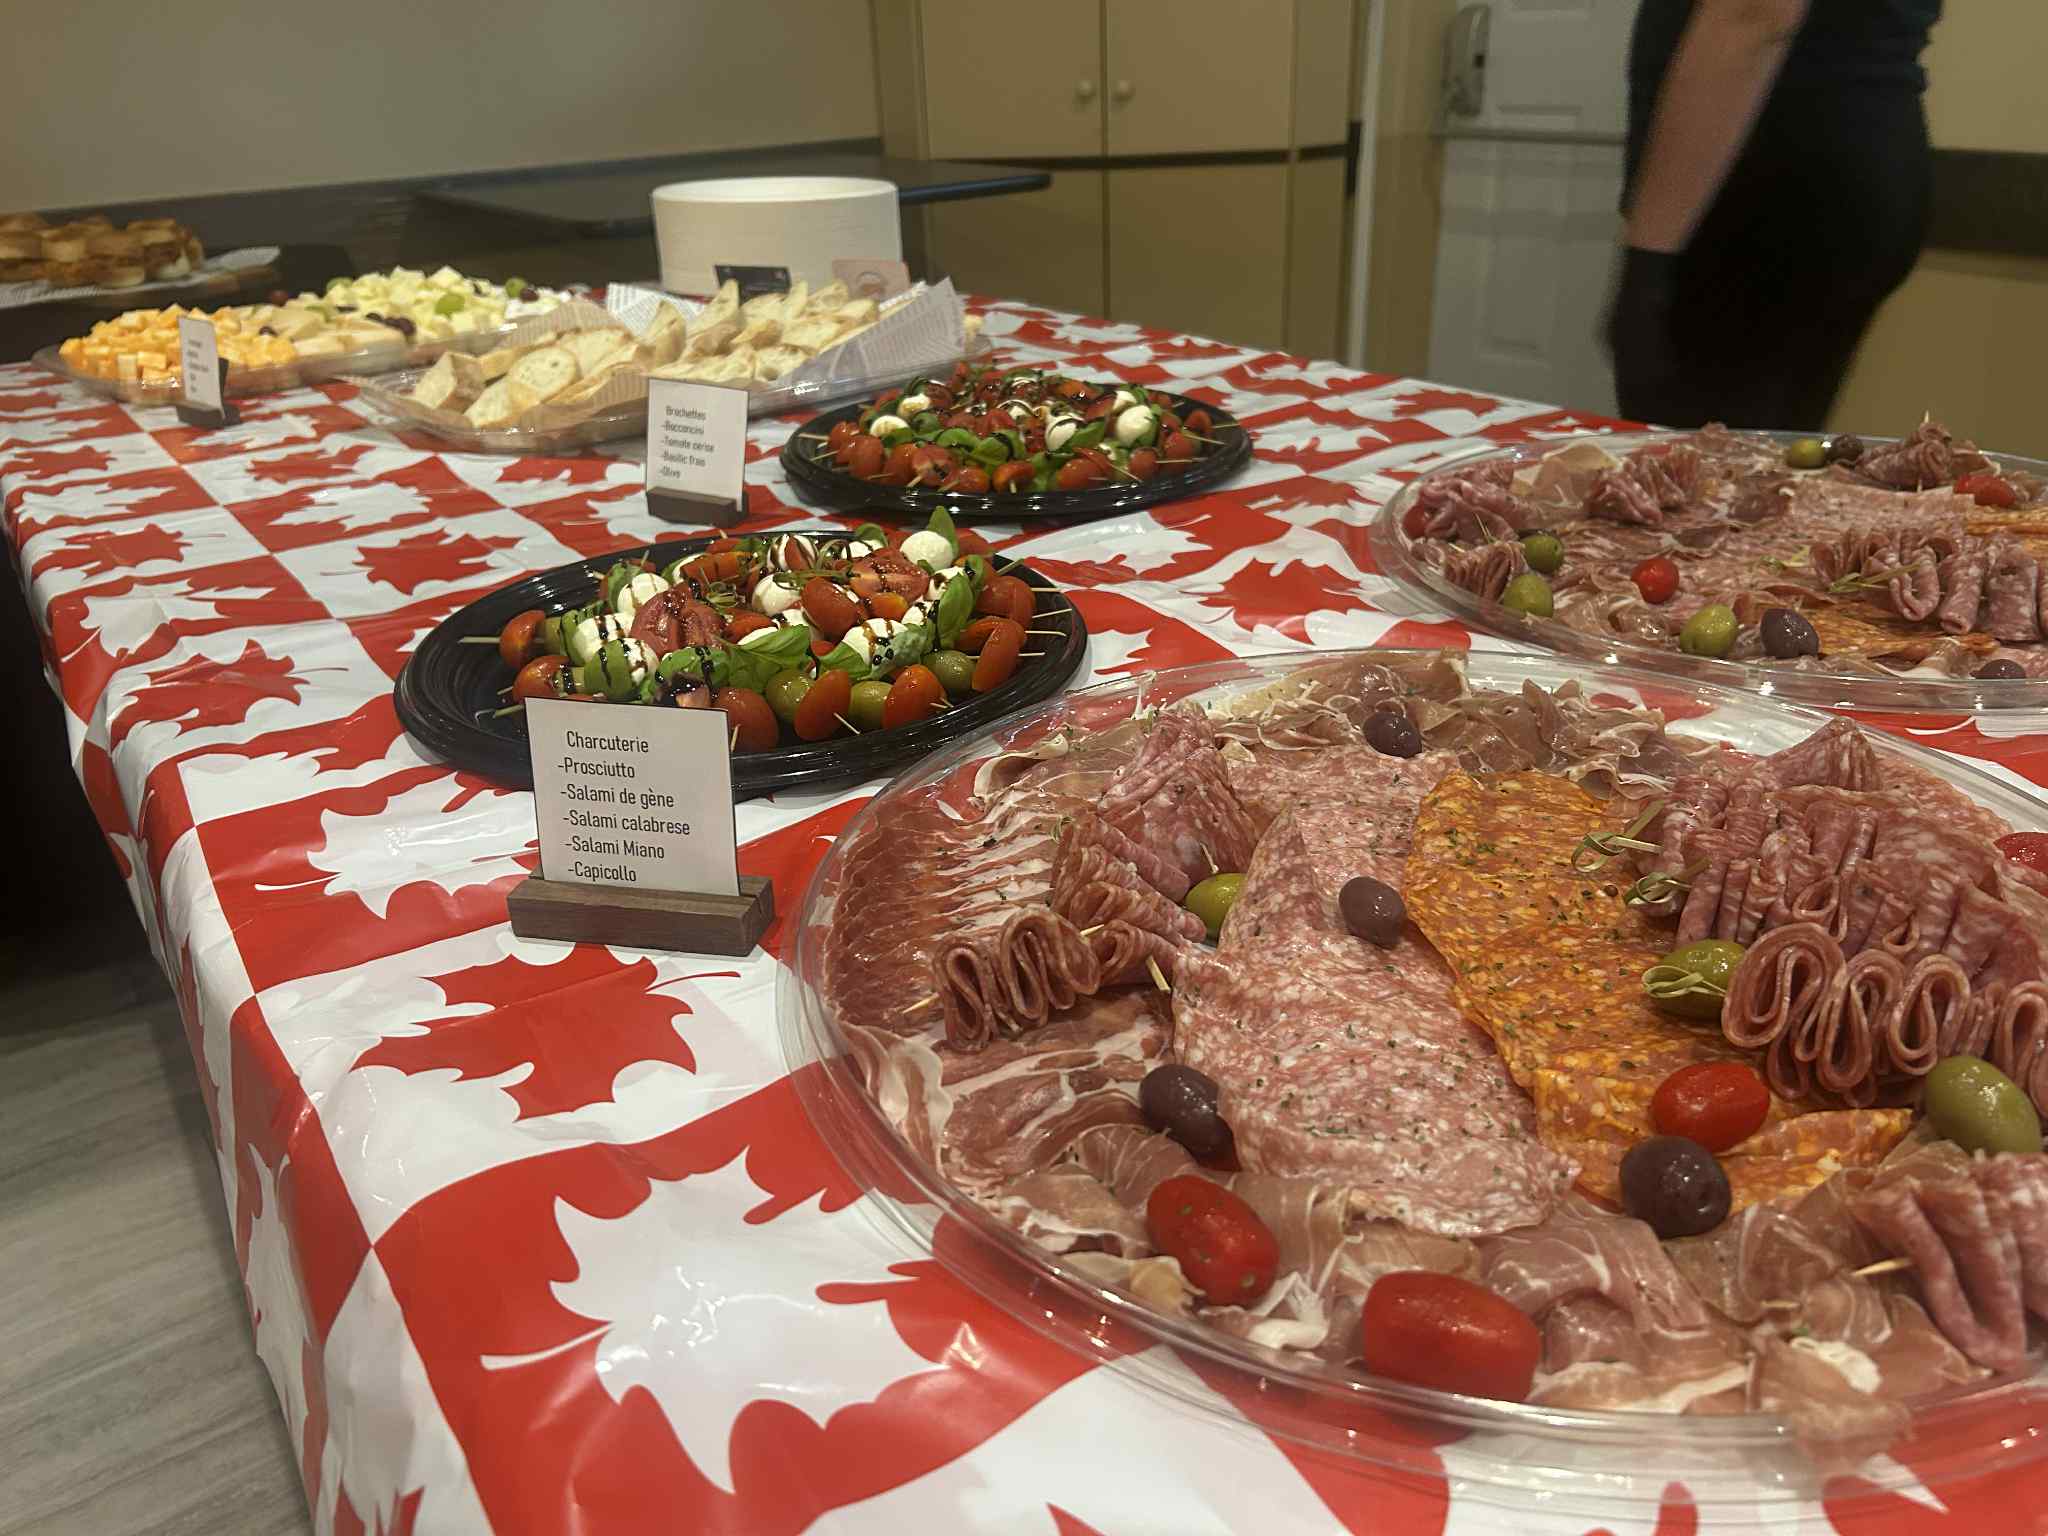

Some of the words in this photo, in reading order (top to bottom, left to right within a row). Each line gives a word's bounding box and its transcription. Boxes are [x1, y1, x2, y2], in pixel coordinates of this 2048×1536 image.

[566, 730, 649, 753] Charcuterie
[558, 757, 635, 779] -Prosciutto
[560, 783, 615, 803] -Salami
[619, 788, 636, 805] de
[640, 787, 674, 810] gène
[563, 810, 617, 829] -Salami
[622, 815, 690, 836] calabrese
[565, 835, 619, 855] -Salami
[623, 839, 665, 859] Miano
[568, 861, 637, 882] -Capicollo
